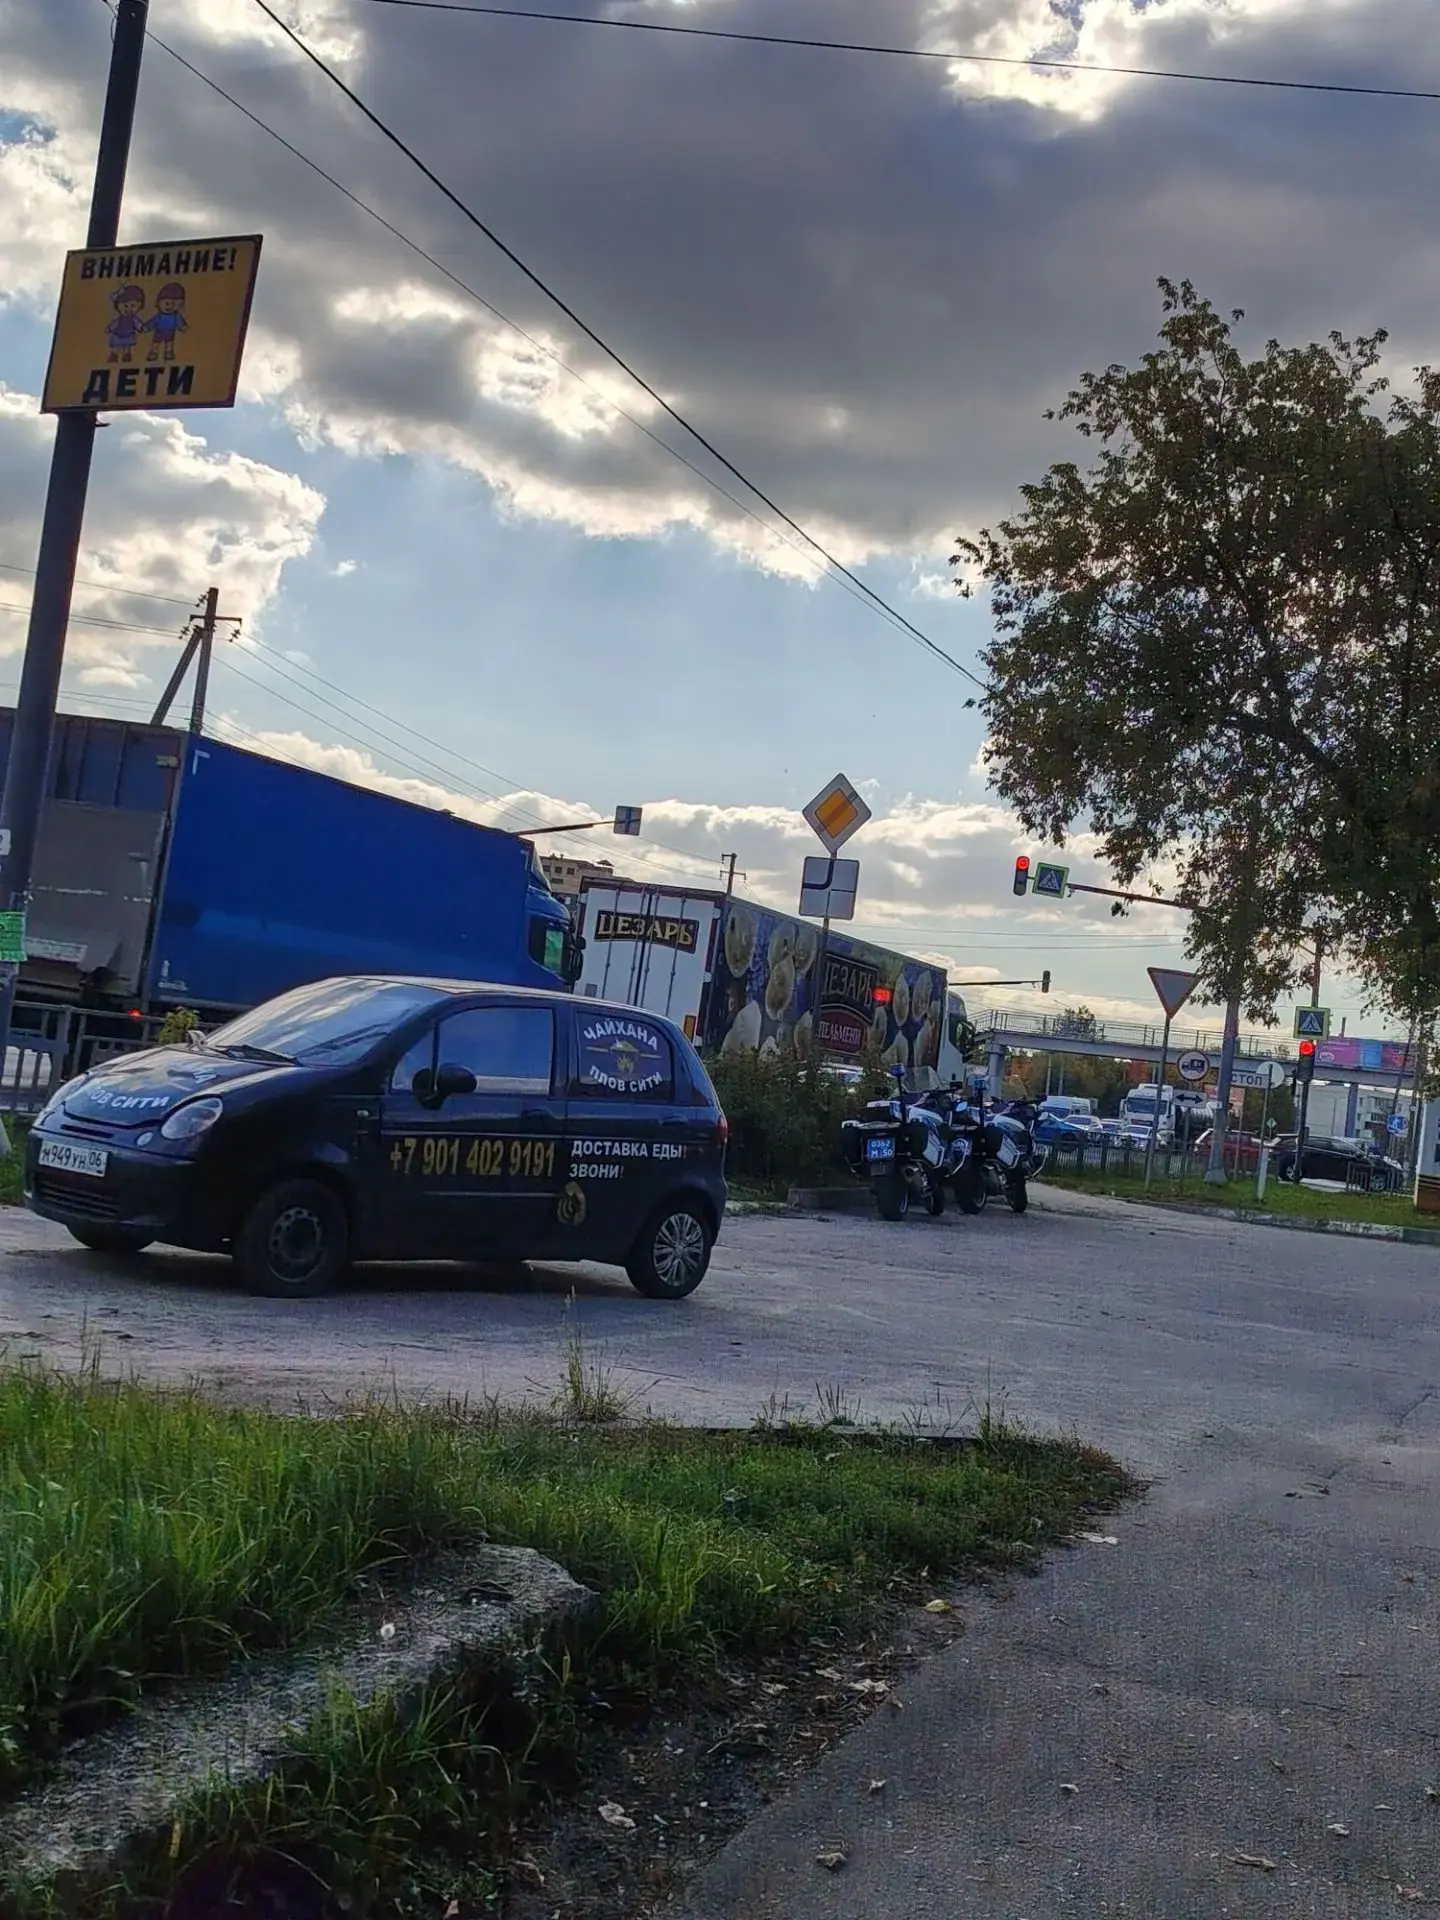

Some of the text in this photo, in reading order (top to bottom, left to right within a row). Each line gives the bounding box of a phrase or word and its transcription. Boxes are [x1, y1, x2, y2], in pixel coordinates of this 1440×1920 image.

[80, 248, 238, 280] ВНИМАНИЕ!
[81, 365, 195, 404] ДЕТИ
[597, 913, 694, 945] ЦЕЗАРЬ
[583, 1018, 658, 1051] ЧАЙХАНА
[589, 1064, 663, 1092] ПЛОВ СИТИ
[1231, 1073, 1263, 1086] СТОП
[111, 1095, 170, 1109] СИТИ
[88, 1151, 102, 1167] 06
[390, 1138, 556, 1177] +7 901 402 9191
[571, 1140, 687, 1160] ДОСТАВКА ЕДЫ!
[569, 1163, 624, 1180] ЗВОНИ!
